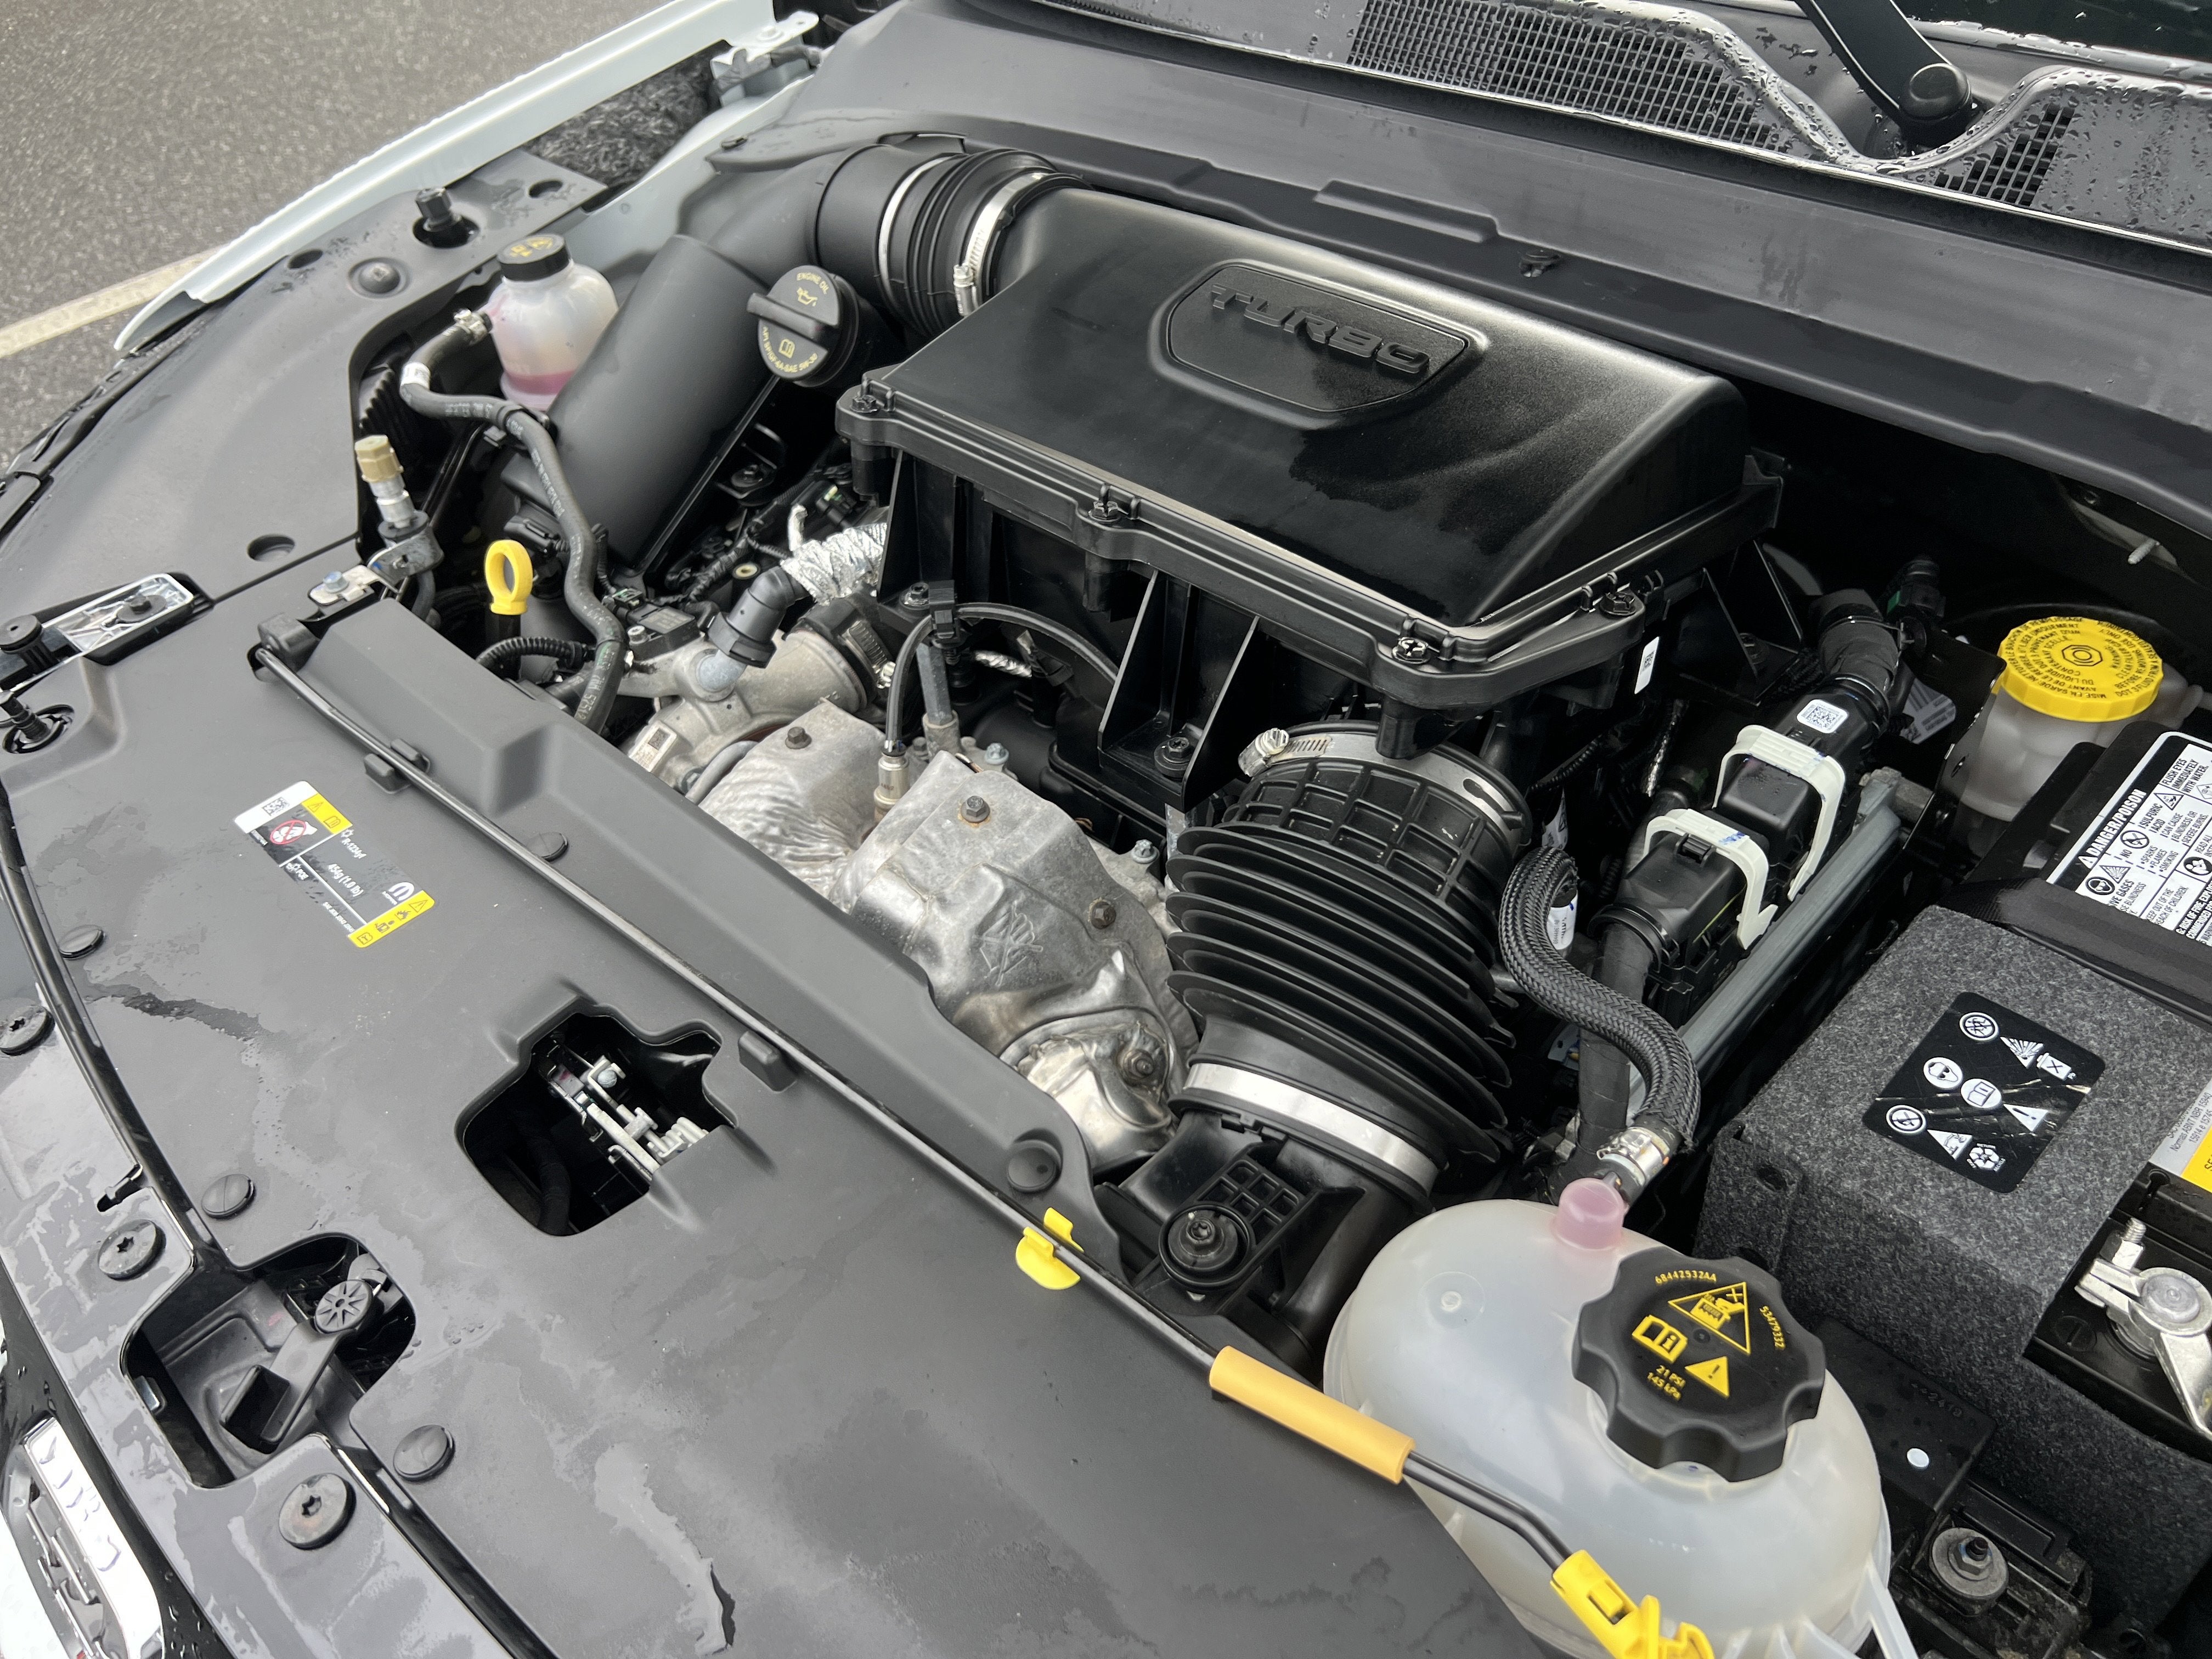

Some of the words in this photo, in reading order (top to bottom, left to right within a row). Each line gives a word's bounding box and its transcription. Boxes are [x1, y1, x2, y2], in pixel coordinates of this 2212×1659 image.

[797, 272, 821, 285] ENGINE
[819, 280, 829, 295] OIL
[1210, 283, 1430, 374] TURBO
[2045, 668, 2079, 684] LIQUIDE
[2162, 770, 2179, 786] FLUSH
[2172, 758, 2187, 771] EYES
[2171, 759, 2199, 789] IMMEDIATELY
[2181, 780, 2196, 793] WITH
[2086, 788, 2147, 857] DANGER/POISON
[2140, 803, 2163, 827] SULFURIC
[2151, 819, 2165, 832] ACID
[2162, 826, 2172, 836] CAN
[2168, 812, 2183, 827] CAUSE
[2171, 817, 2193, 840] BLINDNESS
[2181, 827, 2198, 844] SEVERE
[342, 838, 366, 859] R-1234yf
[2120, 849, 2132, 859] NO
[2194, 842, 2208, 854] READ
[328, 864, 344, 883] 454g
[338, 875, 353, 890] (1.0
[350, 884, 364, 897] lb)
[2116, 879, 2134, 896] GASES
[2124, 882, 2146, 905] BLINDNESS
[2152, 901, 2163, 911] OUT
[2162, 888, 2174, 897] THE
[2179, 917, 2193, 929] RISK
[2187, 911, 2197, 919] OF
[2170, 1133, 2187, 1152] Normas
[2182, 1118, 2195, 1133] ABNT
[2191, 1107, 2203, 1119] NBR
[1655, 1270, 1717, 1285] 68442532AA
[1647, 1372, 1665, 1391] 145
[1664, 1383, 1681, 1400] kPa
[1656, 1365, 1669, 1376] 21
[1669, 1373, 1685, 1387] PSI
